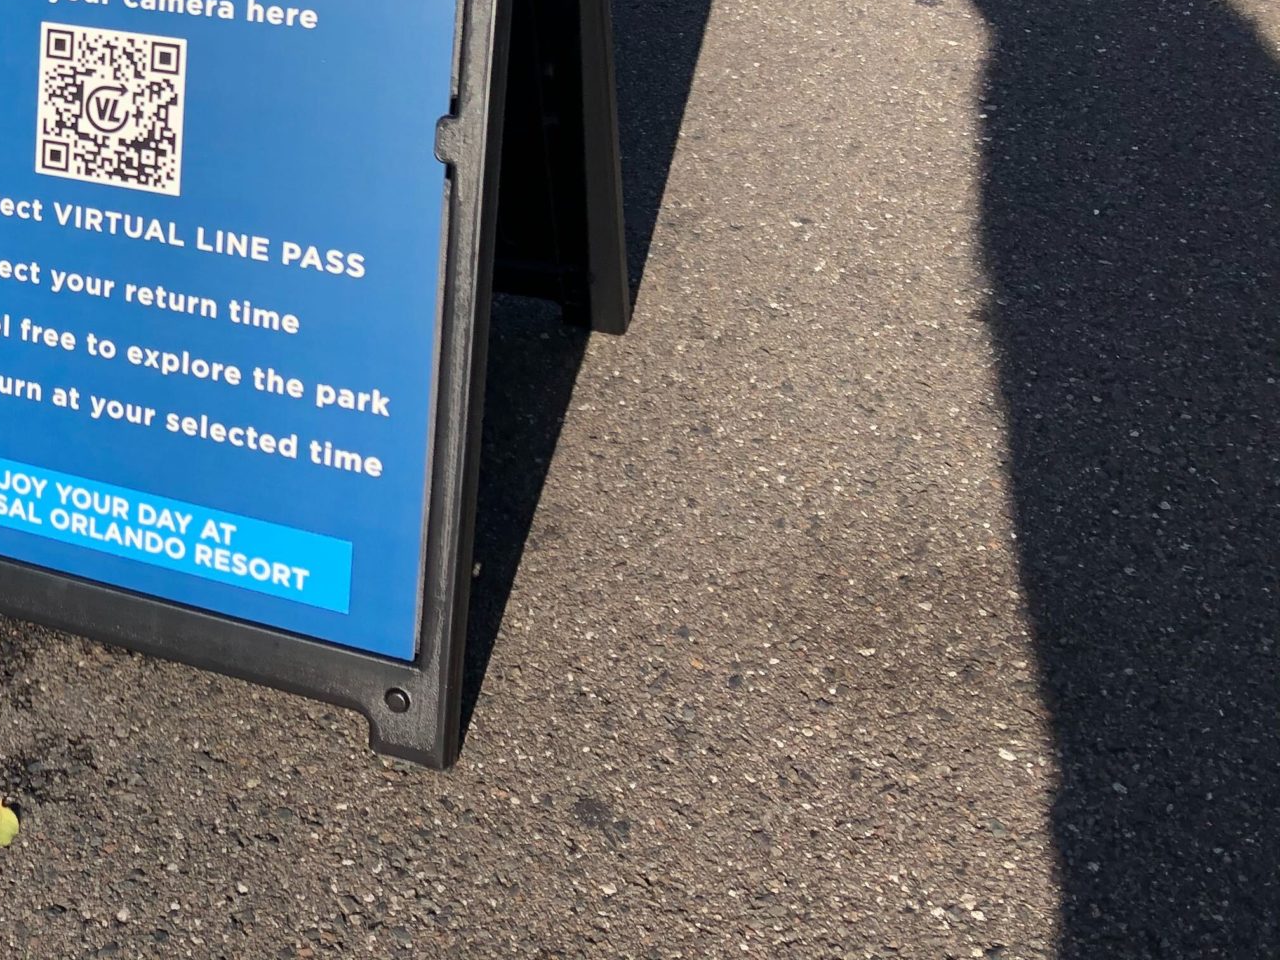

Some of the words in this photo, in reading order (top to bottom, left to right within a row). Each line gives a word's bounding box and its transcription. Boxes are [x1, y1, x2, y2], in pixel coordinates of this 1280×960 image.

[95, 96, 120, 123] VL
[53, 202, 185, 248] VIRTUAL
[197, 227, 270, 262] LINE
[282, 241, 366, 279] PASS
[51, 263, 115, 299] your
[125, 283, 217, 319] return
[229, 298, 301, 335] time
[20, 318, 76, 351] free
[86, 333, 116, 359] to
[127, 346, 242, 386] explore
[253, 367, 304, 398] the
[316, 383, 390, 418] park
[52, 388, 80, 410] at
[90, 395, 156, 428] your
[166, 412, 298, 460] selected
[309, 439, 383, 478] time
[50, 509, 186, 560] ORLANDO
[195, 543, 310, 591] RESORT
[57, 483, 129, 520] YOUR
[138, 503, 192, 535] DAY
[201, 520, 236, 546] AT
